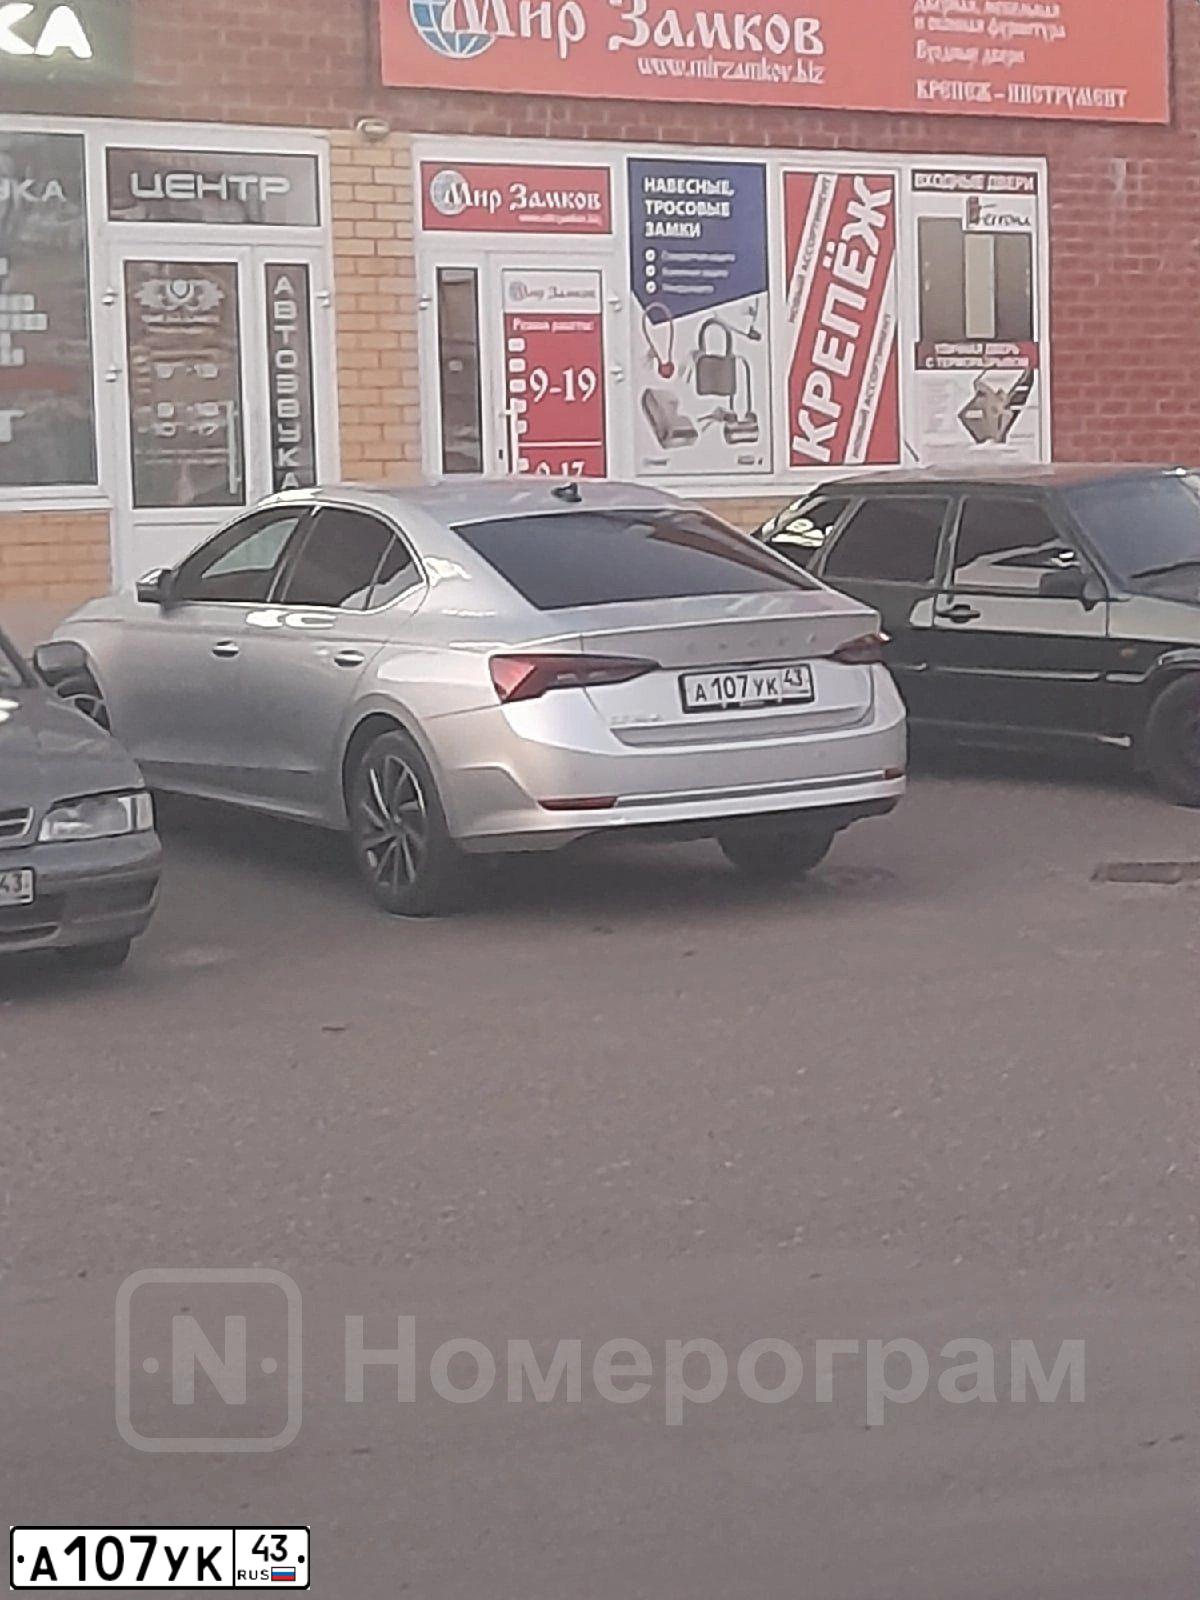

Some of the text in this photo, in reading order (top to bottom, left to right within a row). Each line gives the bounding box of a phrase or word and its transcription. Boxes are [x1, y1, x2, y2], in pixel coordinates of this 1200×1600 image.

[607, 0, 825, 56] Замков
[130, 173, 291, 202] ЦЕНТР
[443, 181, 602, 214] Мир Замков
[644, 199, 732, 218] ТРОСОВЫЕ
[645, 221, 701, 239] ЗАМКИ
[791, 175, 893, 463] КРЕПЁЖ
[529, 367, 597, 403] 9-19
